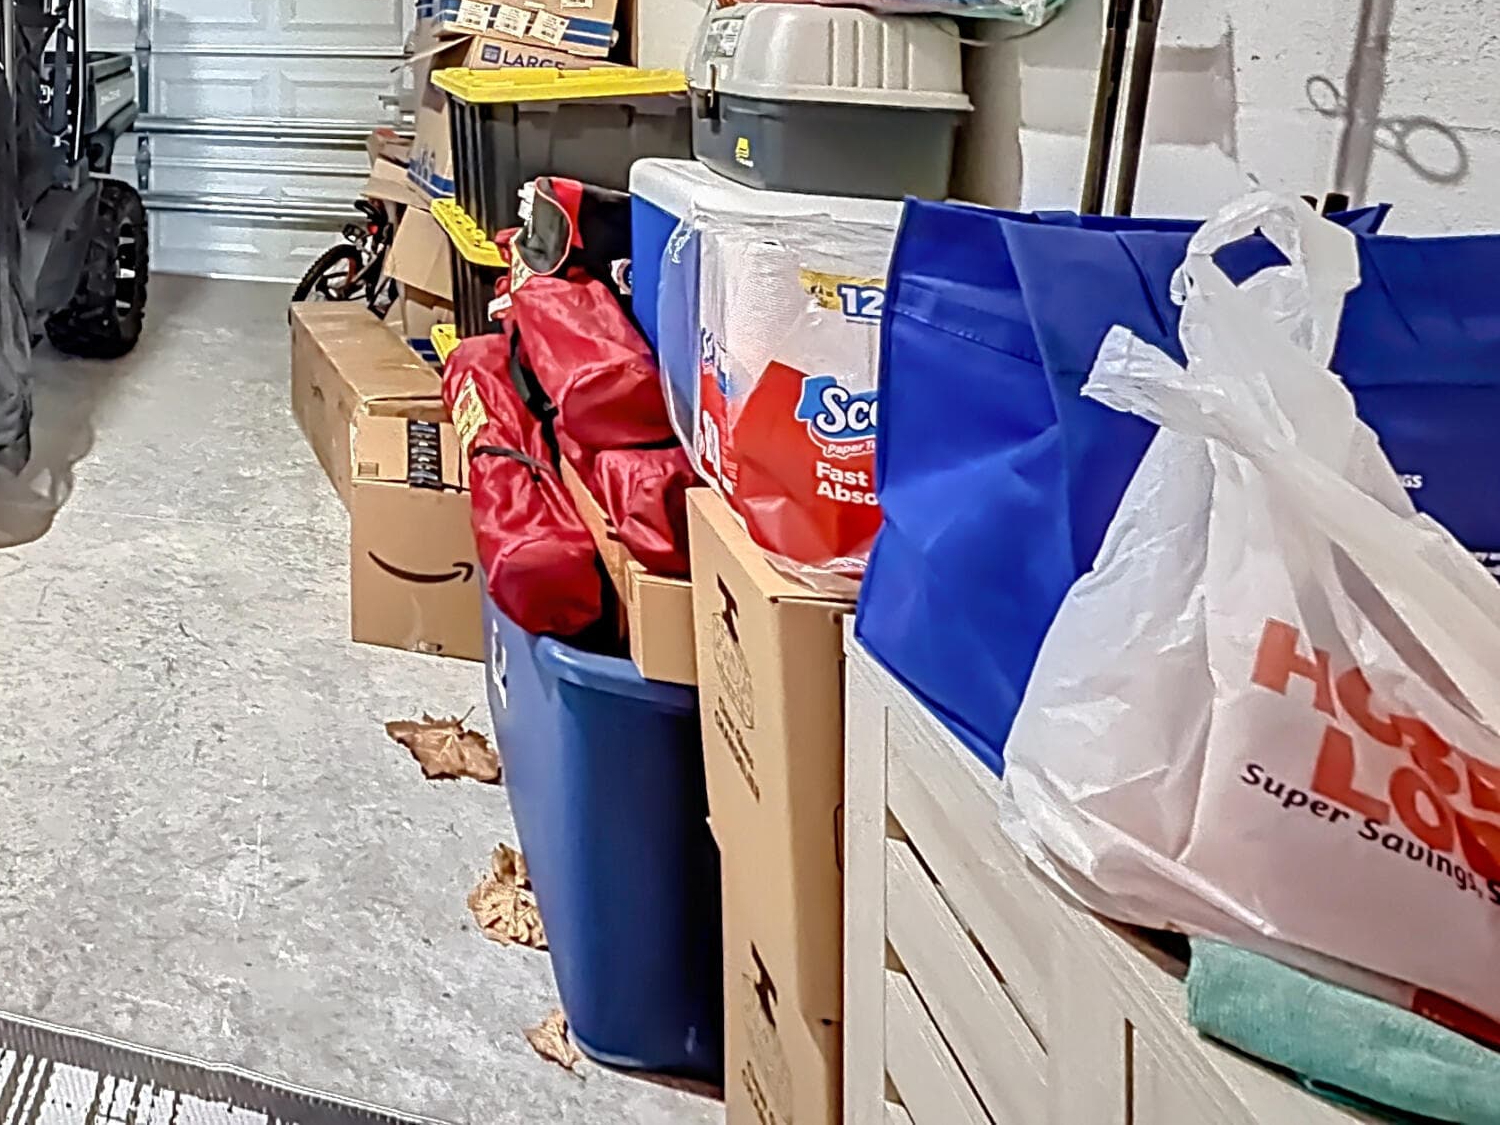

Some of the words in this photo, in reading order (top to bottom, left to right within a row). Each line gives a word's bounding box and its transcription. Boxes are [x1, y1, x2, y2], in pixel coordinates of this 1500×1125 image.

[840, 286, 885, 316] 12
[815, 460, 869, 487] Fast
[1241, 763, 1350, 823] Super
